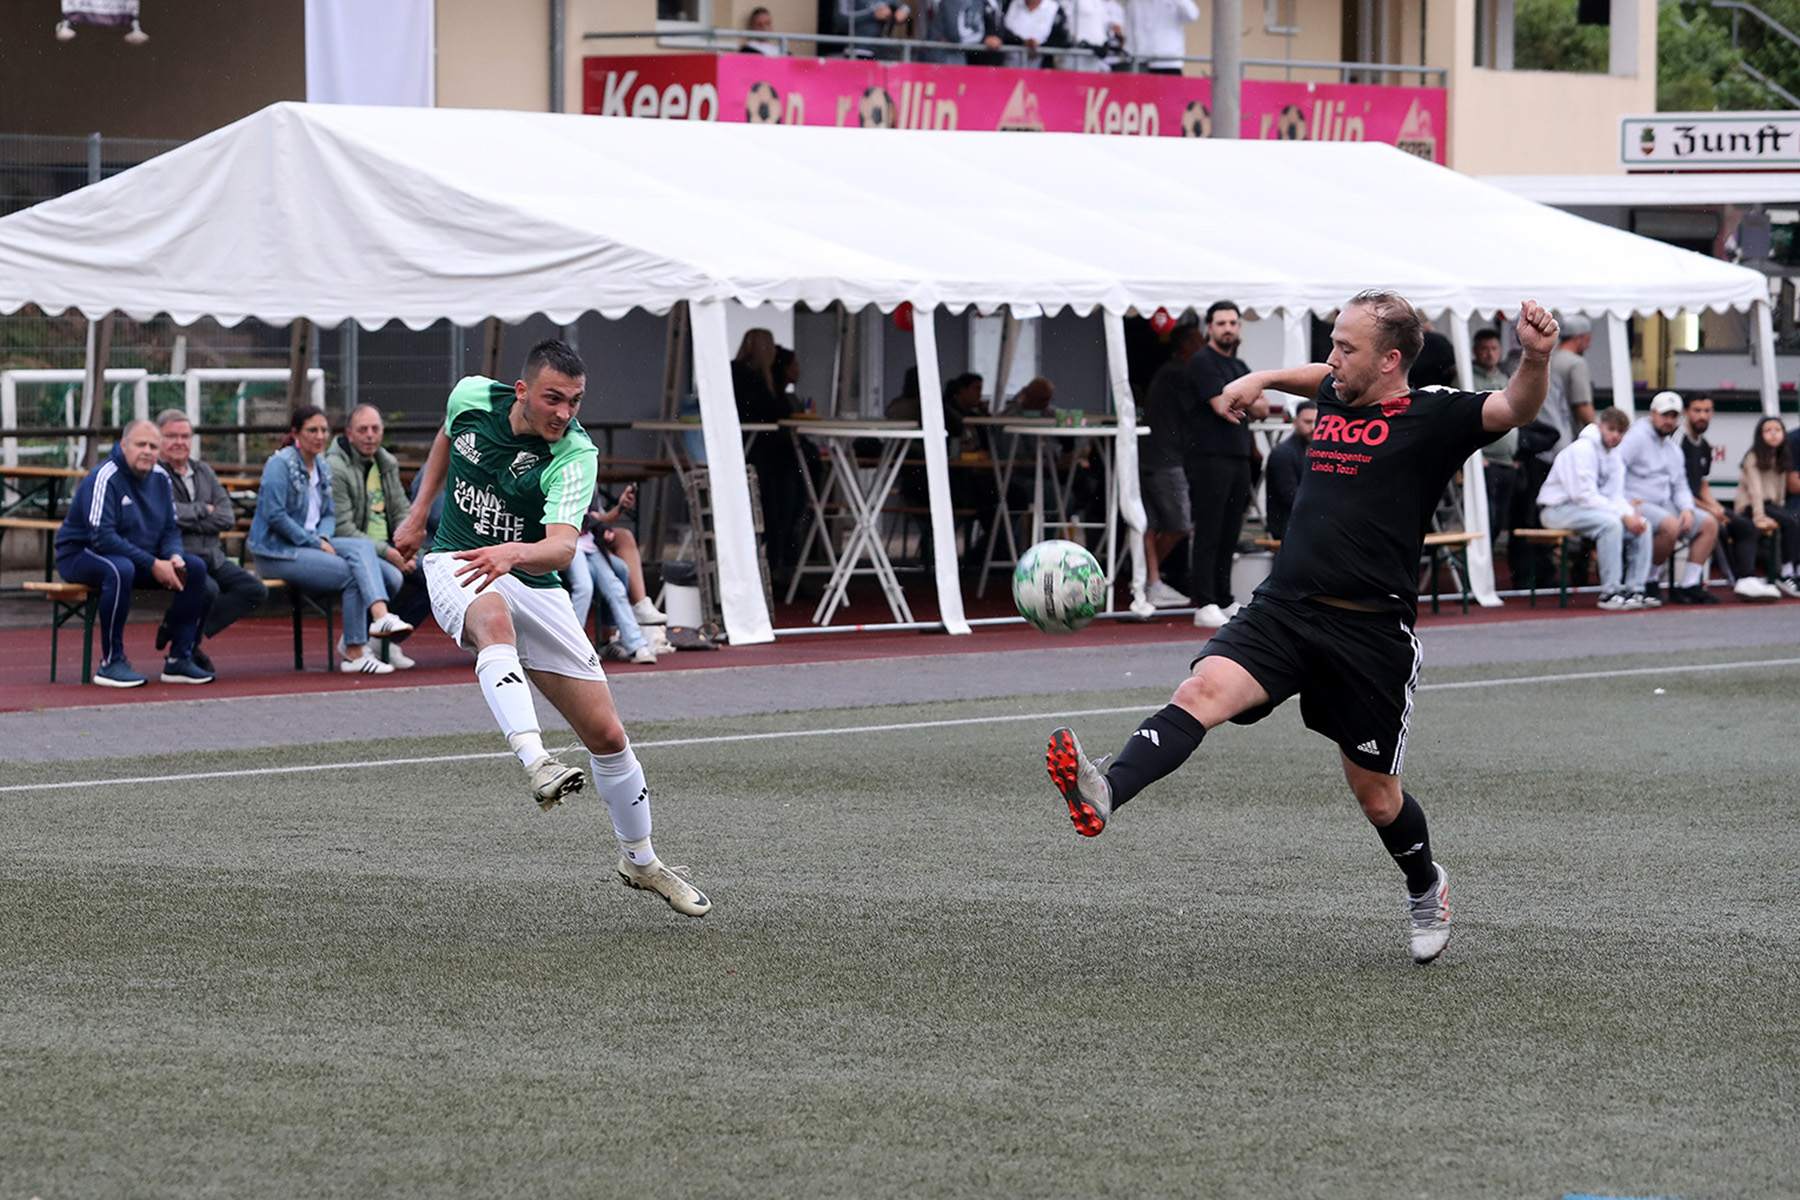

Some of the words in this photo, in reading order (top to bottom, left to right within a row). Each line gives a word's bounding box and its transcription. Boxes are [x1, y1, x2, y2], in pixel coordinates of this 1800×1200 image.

[1673, 124, 1793, 156] Zunft
[1312, 414, 1389, 446] ERGO
[1311, 461, 1335, 473] Linda
[1336, 463, 1359, 475] Tozzi
